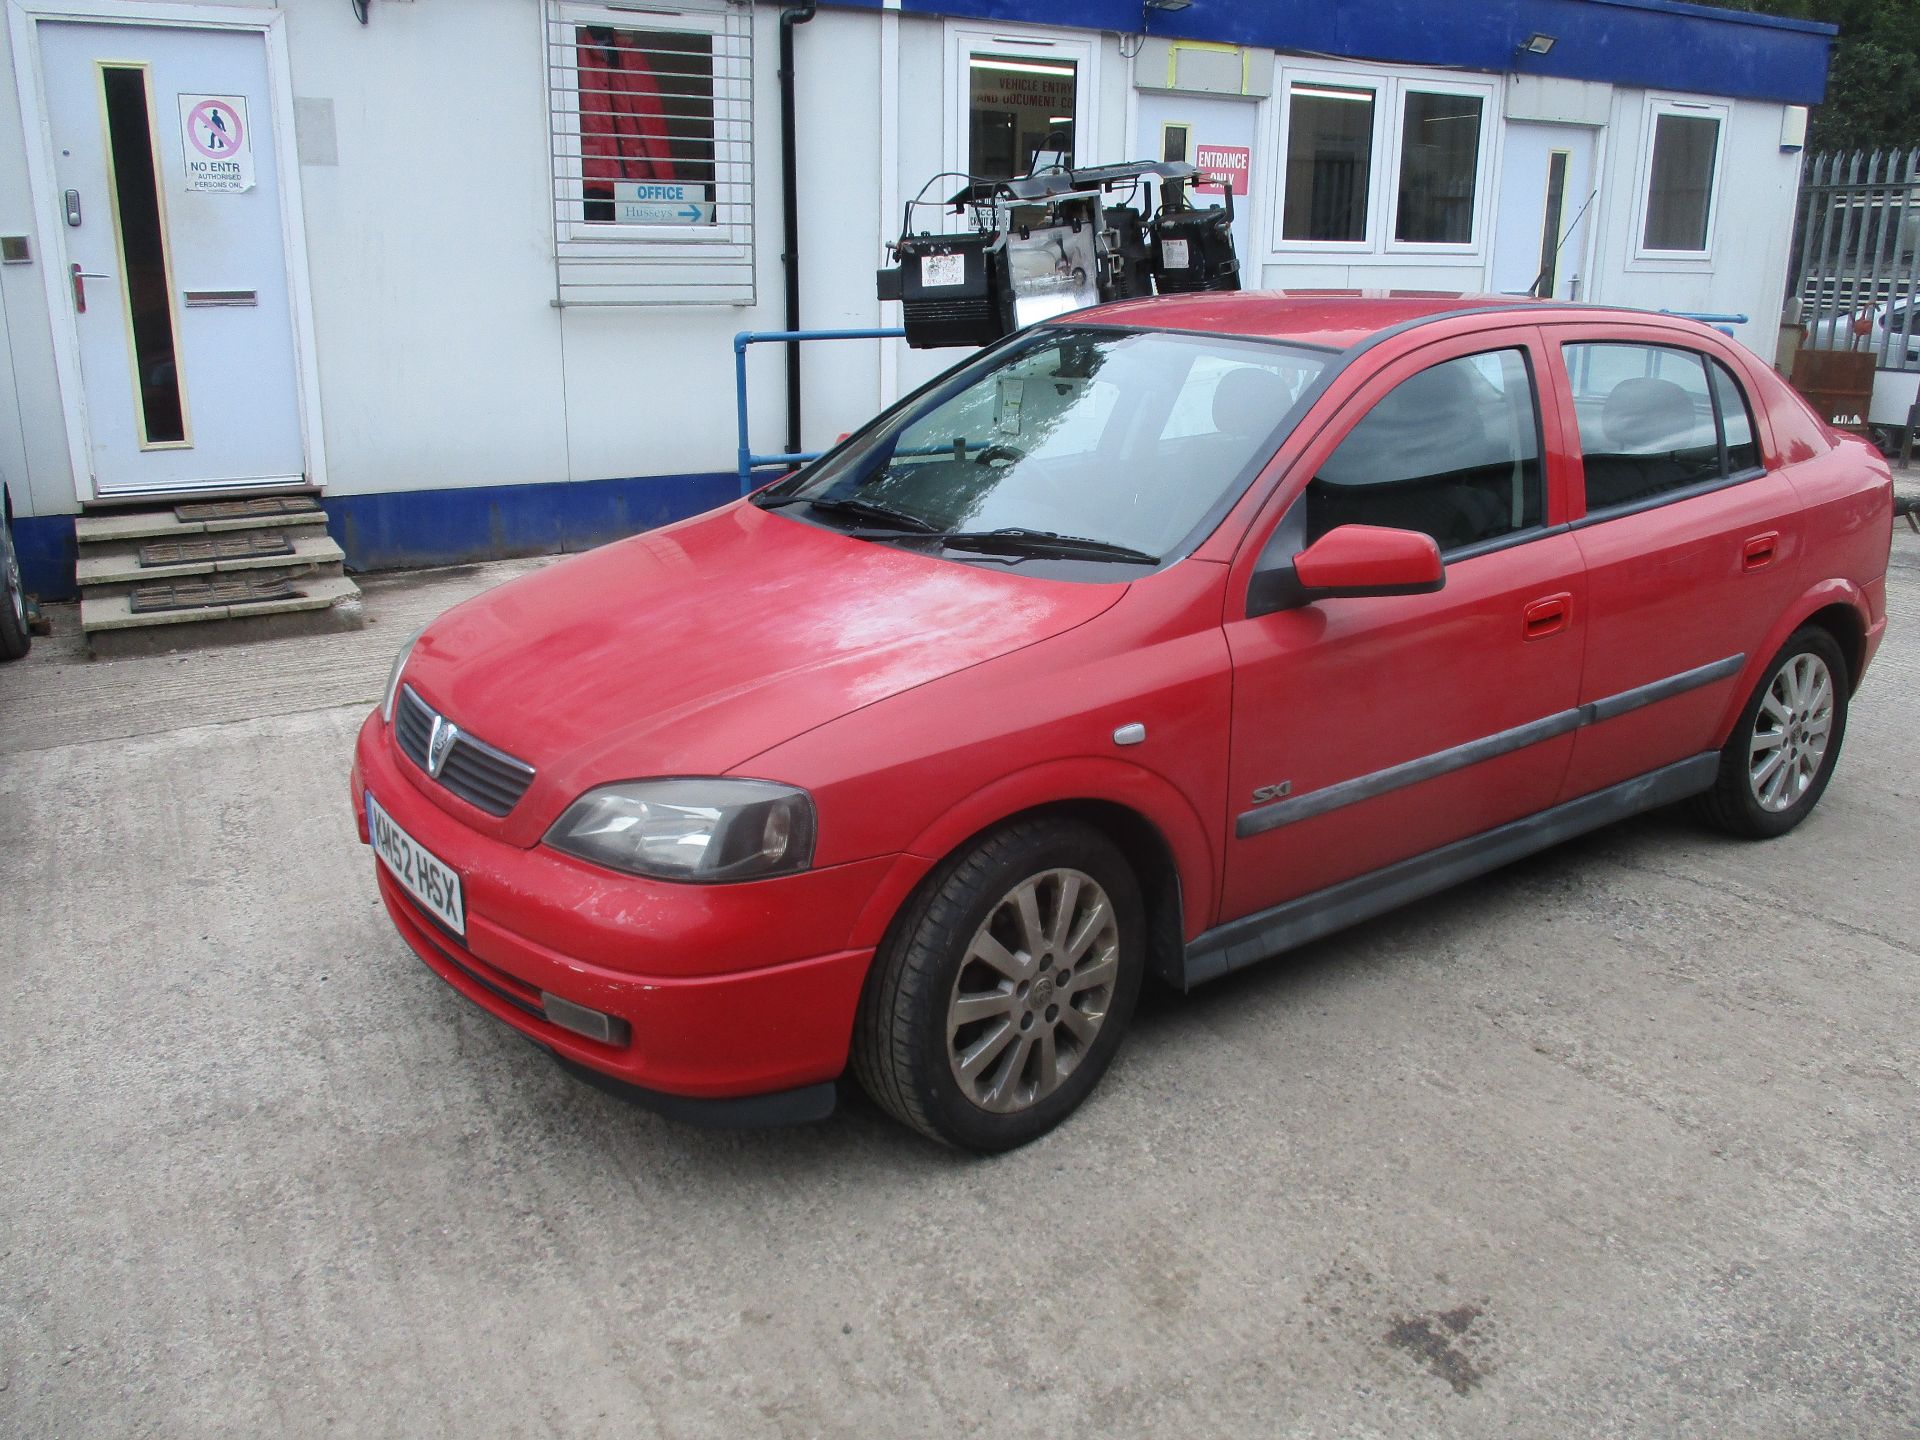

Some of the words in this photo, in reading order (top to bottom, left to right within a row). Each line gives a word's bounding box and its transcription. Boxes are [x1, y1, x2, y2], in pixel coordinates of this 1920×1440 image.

[1000, 78, 1038, 92] VEHICLE
[1042, 80, 1073, 94] ENTRY
[1003, 93, 1056, 107] DOCUMENT
[190, 162, 207, 172] NO
[210, 162, 240, 172] ENTR
[1199, 151, 1247, 169] ENTRANCE
[1210, 172, 1234, 189] ONLY
[637, 185, 684, 200] OFFICE
[626, 206, 673, 218] Husseys
[416, 850, 459, 923] HSX
